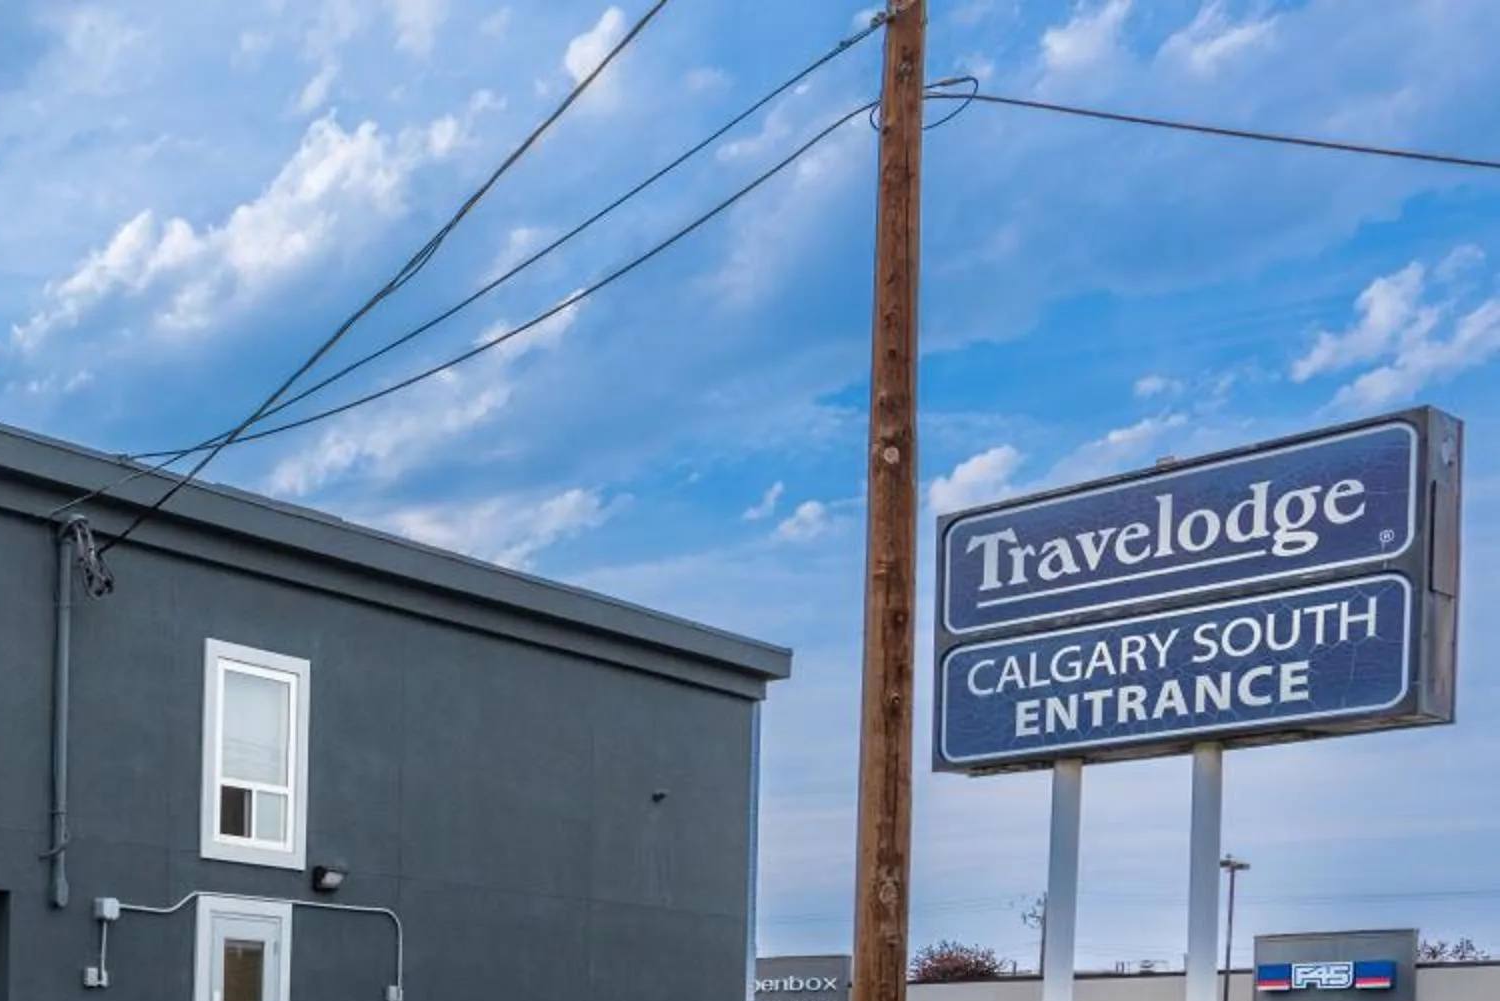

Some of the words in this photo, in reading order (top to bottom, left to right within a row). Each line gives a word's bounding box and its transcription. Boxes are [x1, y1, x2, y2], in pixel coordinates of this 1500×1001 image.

[966, 478, 1366, 592] Travelodge
[967, 628, 1181, 696] CALGARY
[1192, 596, 1378, 662] SOUTH
[1015, 660, 1311, 737] ENTRANCE
[1294, 964, 1351, 987] F45
